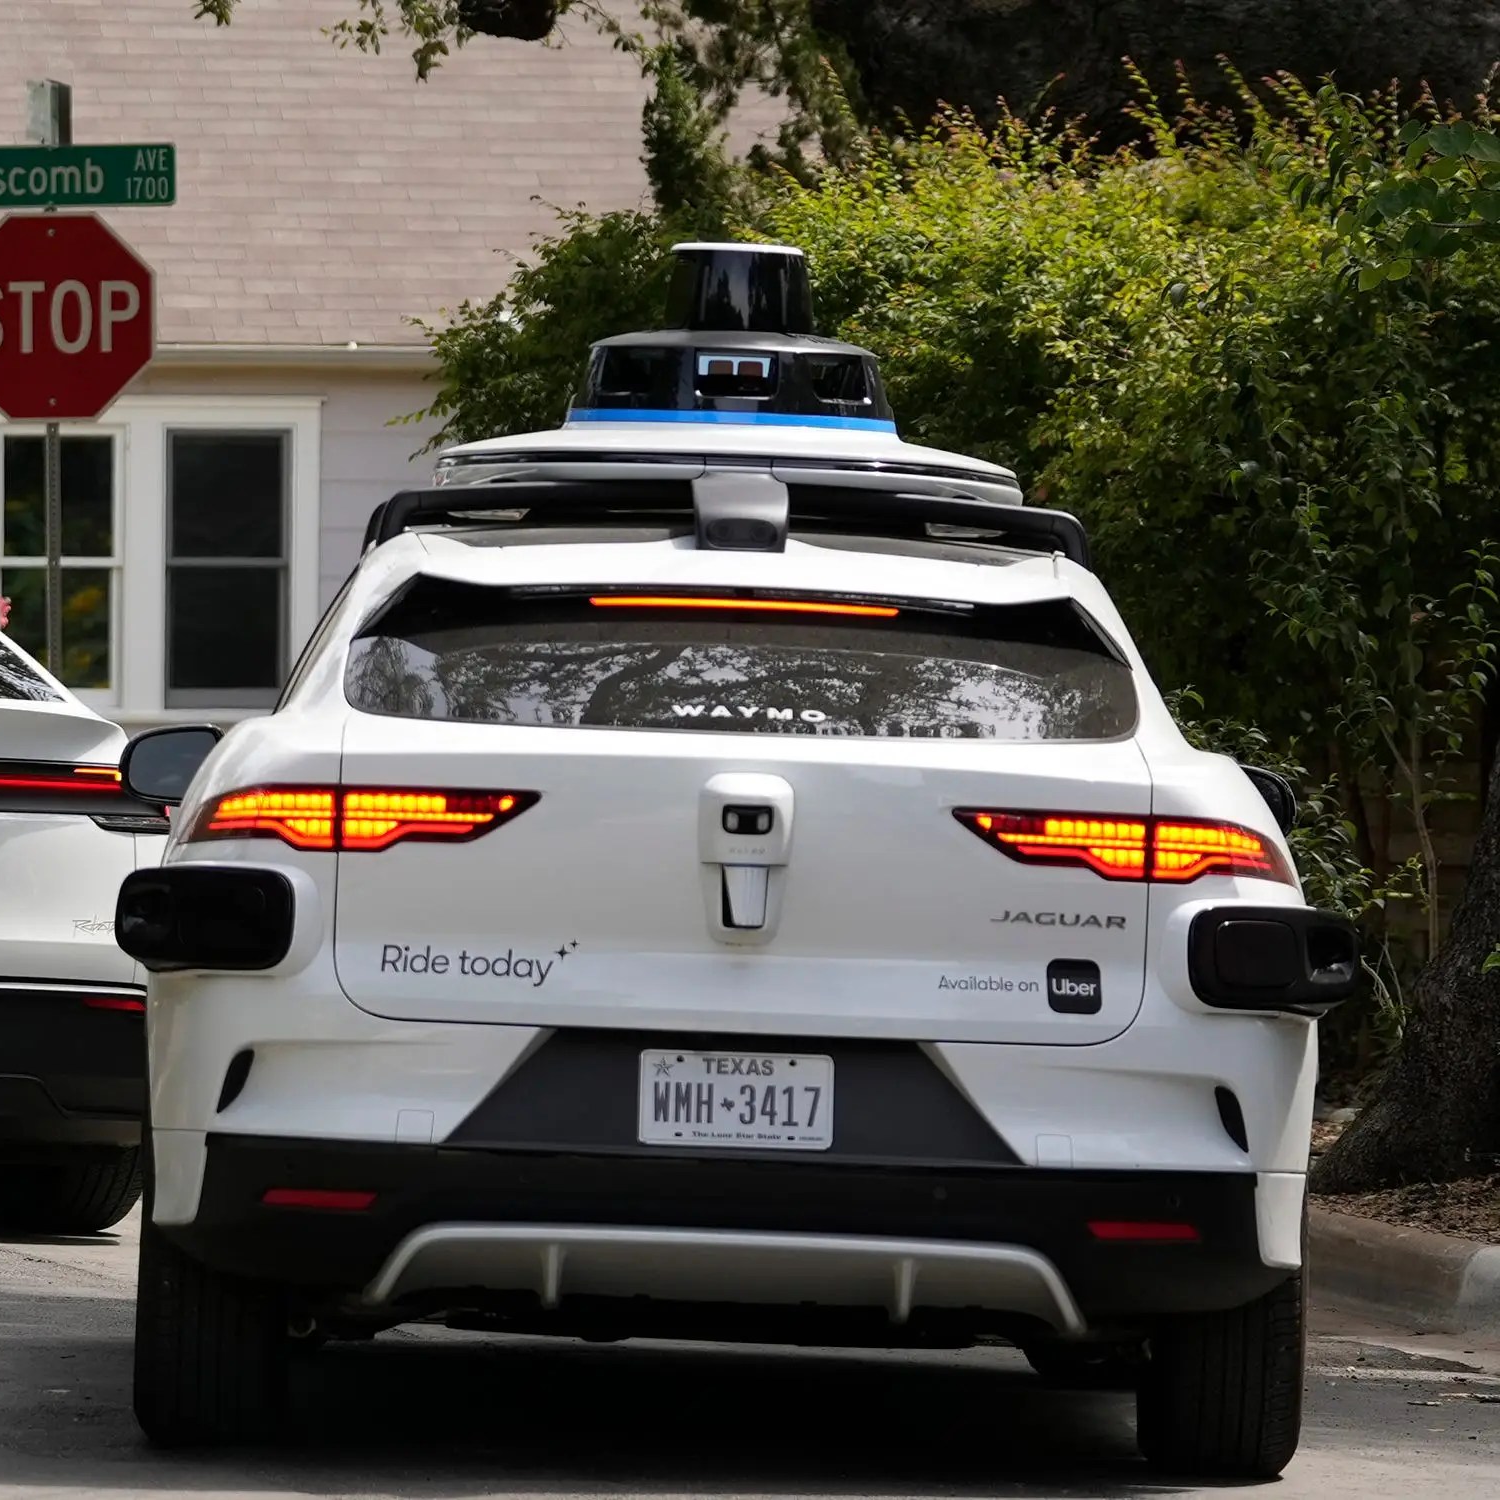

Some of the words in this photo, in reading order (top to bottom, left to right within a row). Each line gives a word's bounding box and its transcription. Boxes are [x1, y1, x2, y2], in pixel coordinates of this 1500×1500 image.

[134, 149, 169, 172] AVE
[125, 176, 169, 200] 1700
[671, 704, 826, 722] WAYMO
[990, 910, 1127, 930] JAGUAR
[380, 944, 450, 974] Ride
[458, 948, 554, 987] today
[938, 975, 1014, 992] Available
[1018, 979, 1040, 992] on
[1051, 977, 1096, 996] Uber
[702, 1057, 775, 1076] TEXAS
